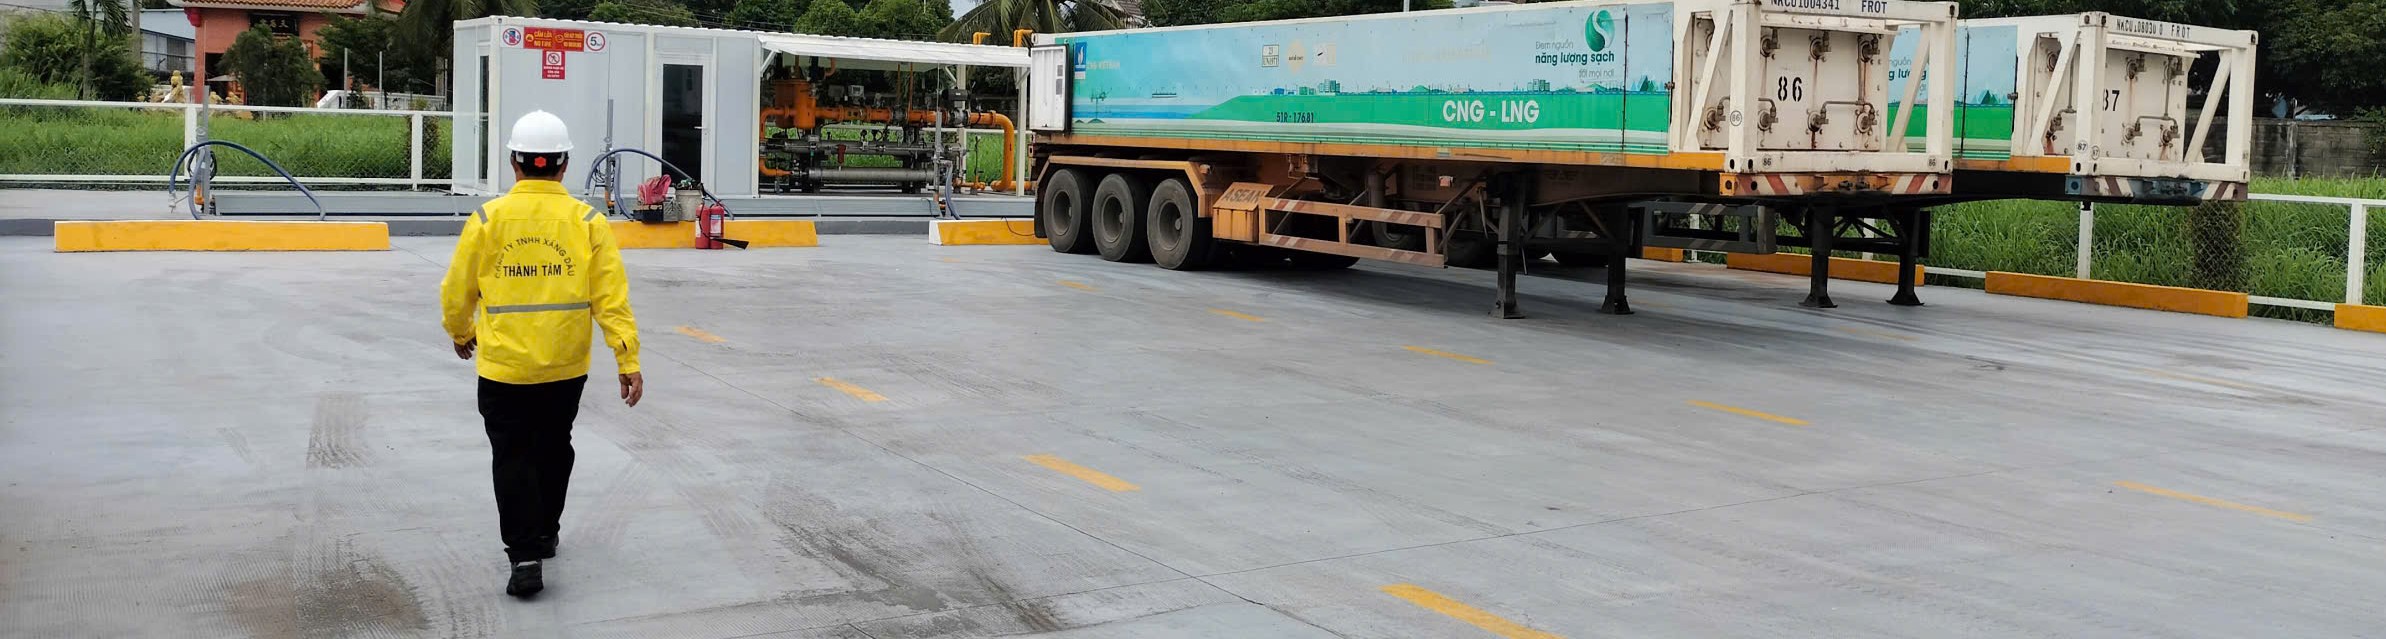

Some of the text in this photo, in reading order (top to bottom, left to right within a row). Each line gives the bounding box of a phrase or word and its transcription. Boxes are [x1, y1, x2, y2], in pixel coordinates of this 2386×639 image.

[1861, 0, 1887, 13] FROT
[2171, 24, 2190, 38] FROT
[1535, 50, 1615, 66] năng lượng sạch
[1778, 76, 1802, 102] 86
[1442, 100, 1485, 122] CNG
[1501, 100, 1540, 123] LNG
[2077, 143, 2087, 151] 87
[503, 242, 514, 252] TY
[516, 237, 540, 246] TNHH
[503, 263, 562, 277] THÀNH TÂM
